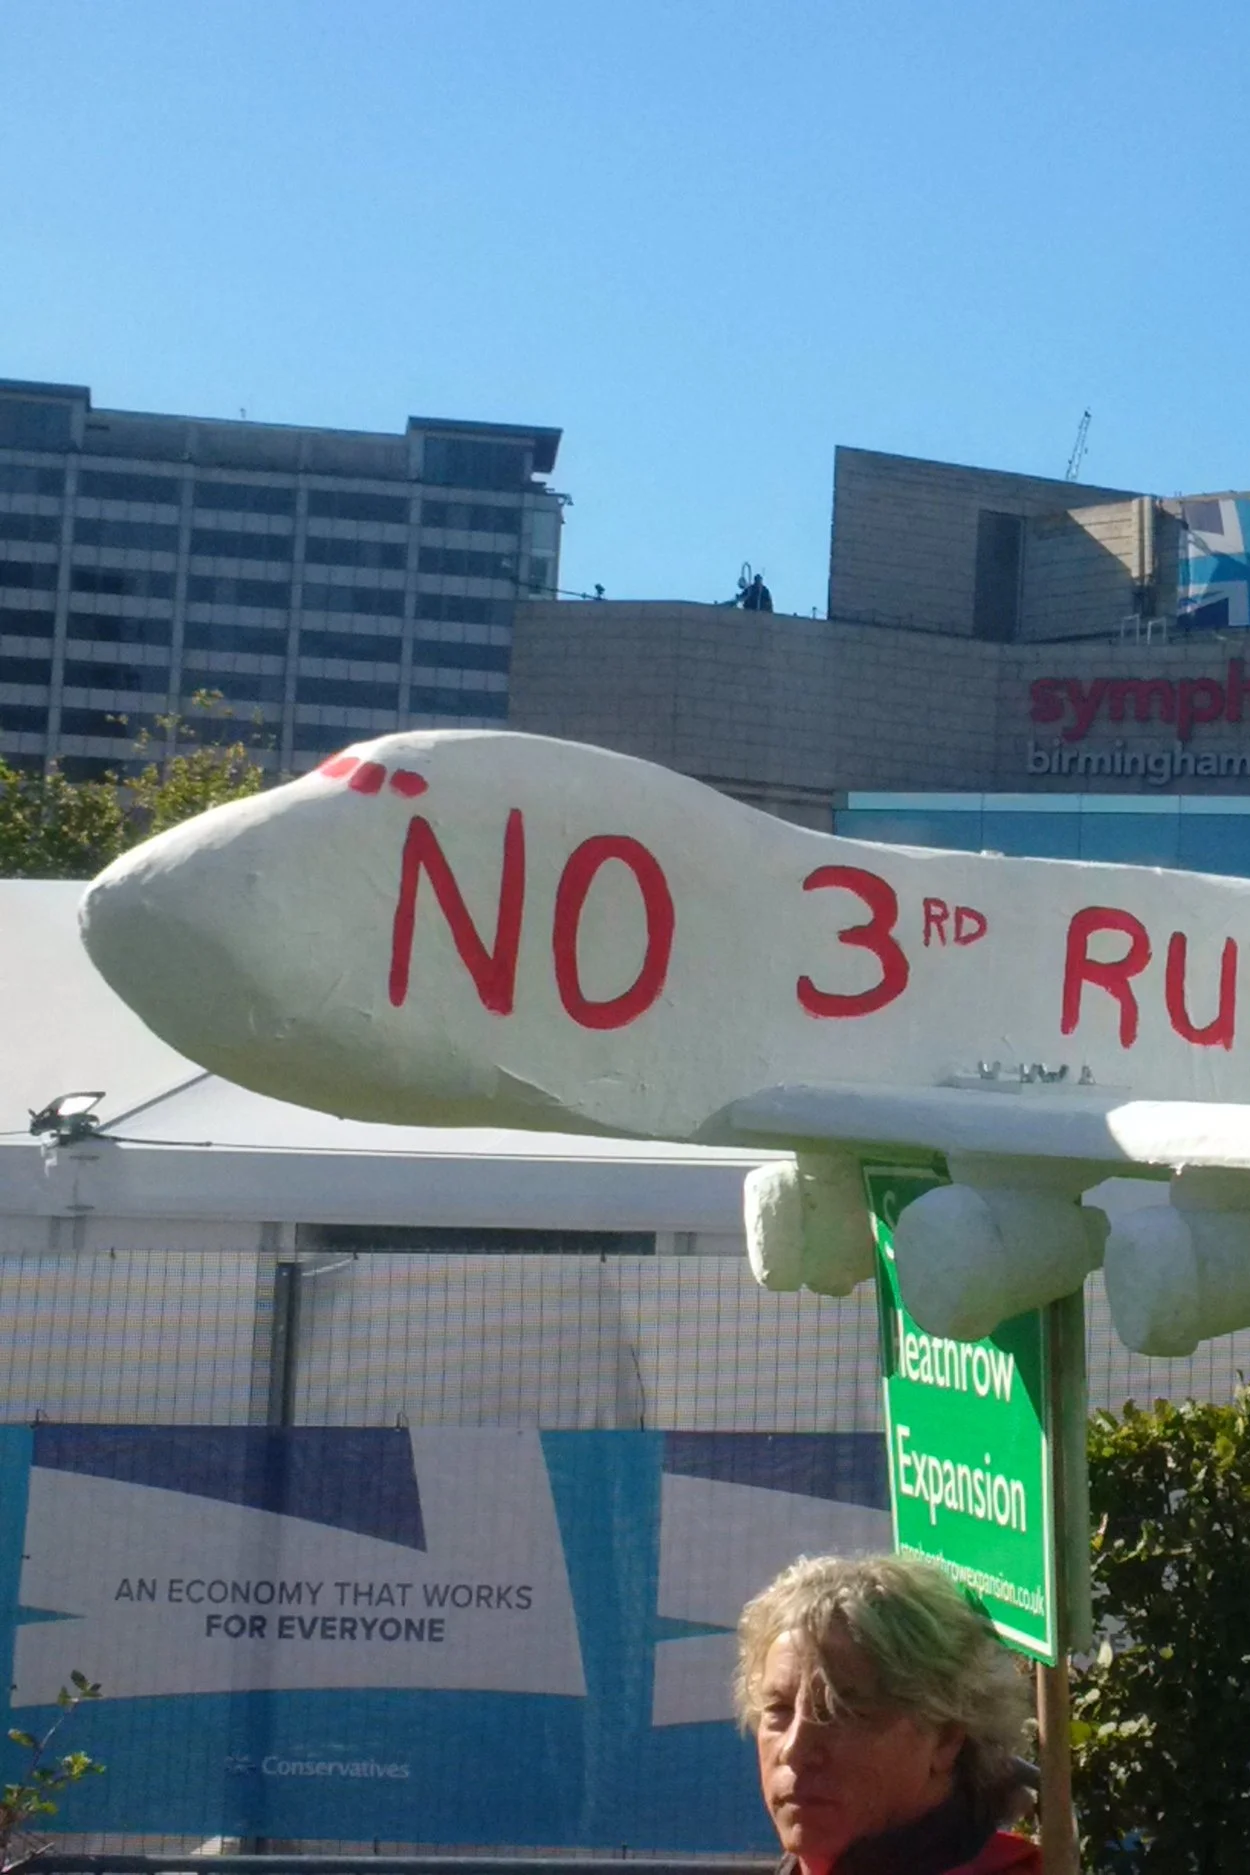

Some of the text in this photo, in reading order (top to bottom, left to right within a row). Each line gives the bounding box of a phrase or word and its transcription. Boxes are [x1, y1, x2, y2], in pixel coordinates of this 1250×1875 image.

[389, 808, 675, 1030] NO
[796, 865, 988, 1019] 3RD
[896, 1423, 1027, 1533] Expansion
[115, 1578, 533, 1610] AN ECONOMY THAT WORKS
[206, 1614, 446, 1643] FOR EVERYONE
[262, 1755, 411, 1779] Conservatives
